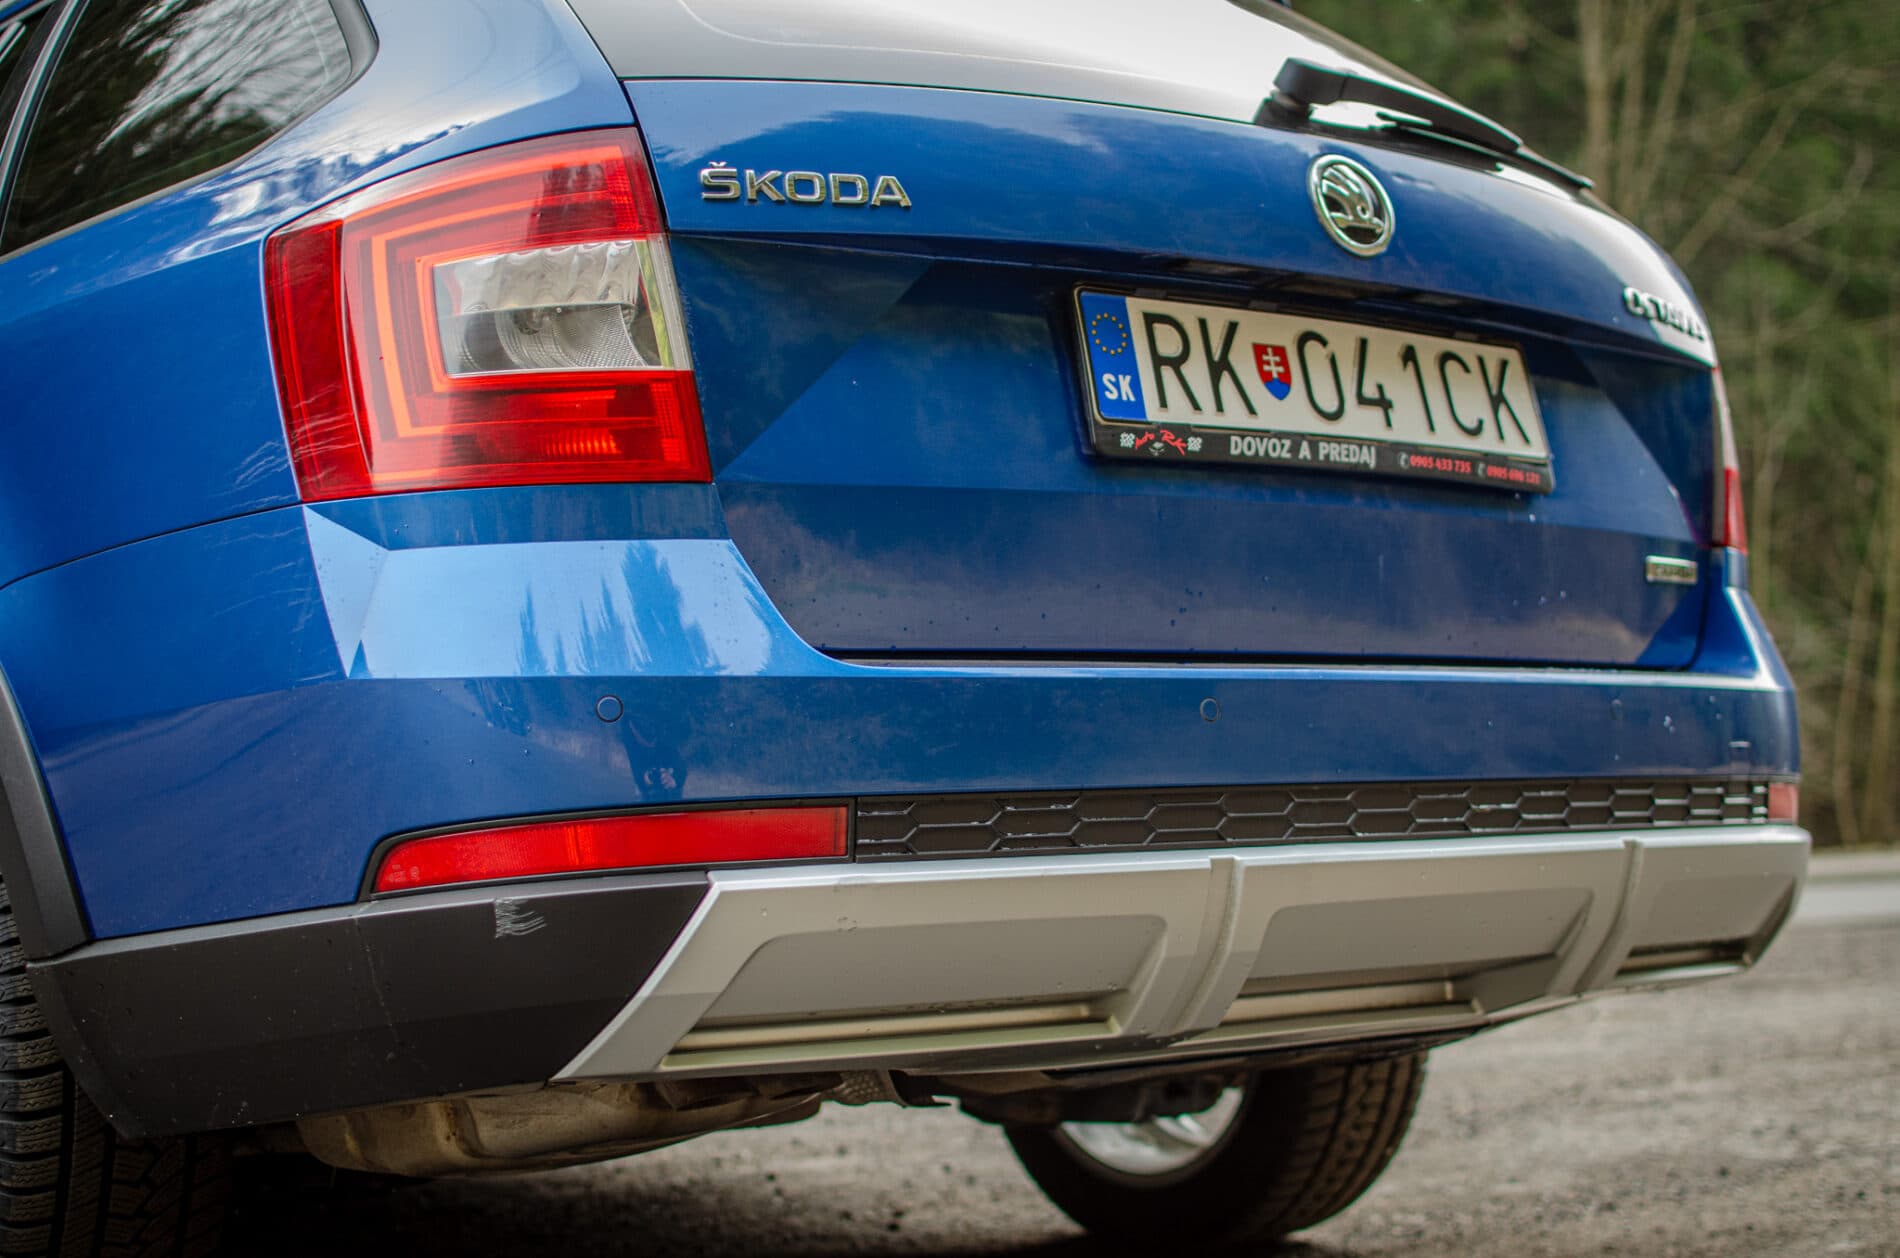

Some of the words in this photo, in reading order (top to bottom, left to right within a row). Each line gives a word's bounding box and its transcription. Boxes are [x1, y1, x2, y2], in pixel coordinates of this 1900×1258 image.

[700, 161, 912, 208] ŠKODA
[1102, 372, 1137, 402] SK
[1142, 311, 1259, 417] RK
[1296, 330, 1532, 446] 041CK
[1230, 435, 1293, 459] DOVOZ
[1298, 439, 1313, 460] A
[1318, 441, 1377, 469] PREDAJ
